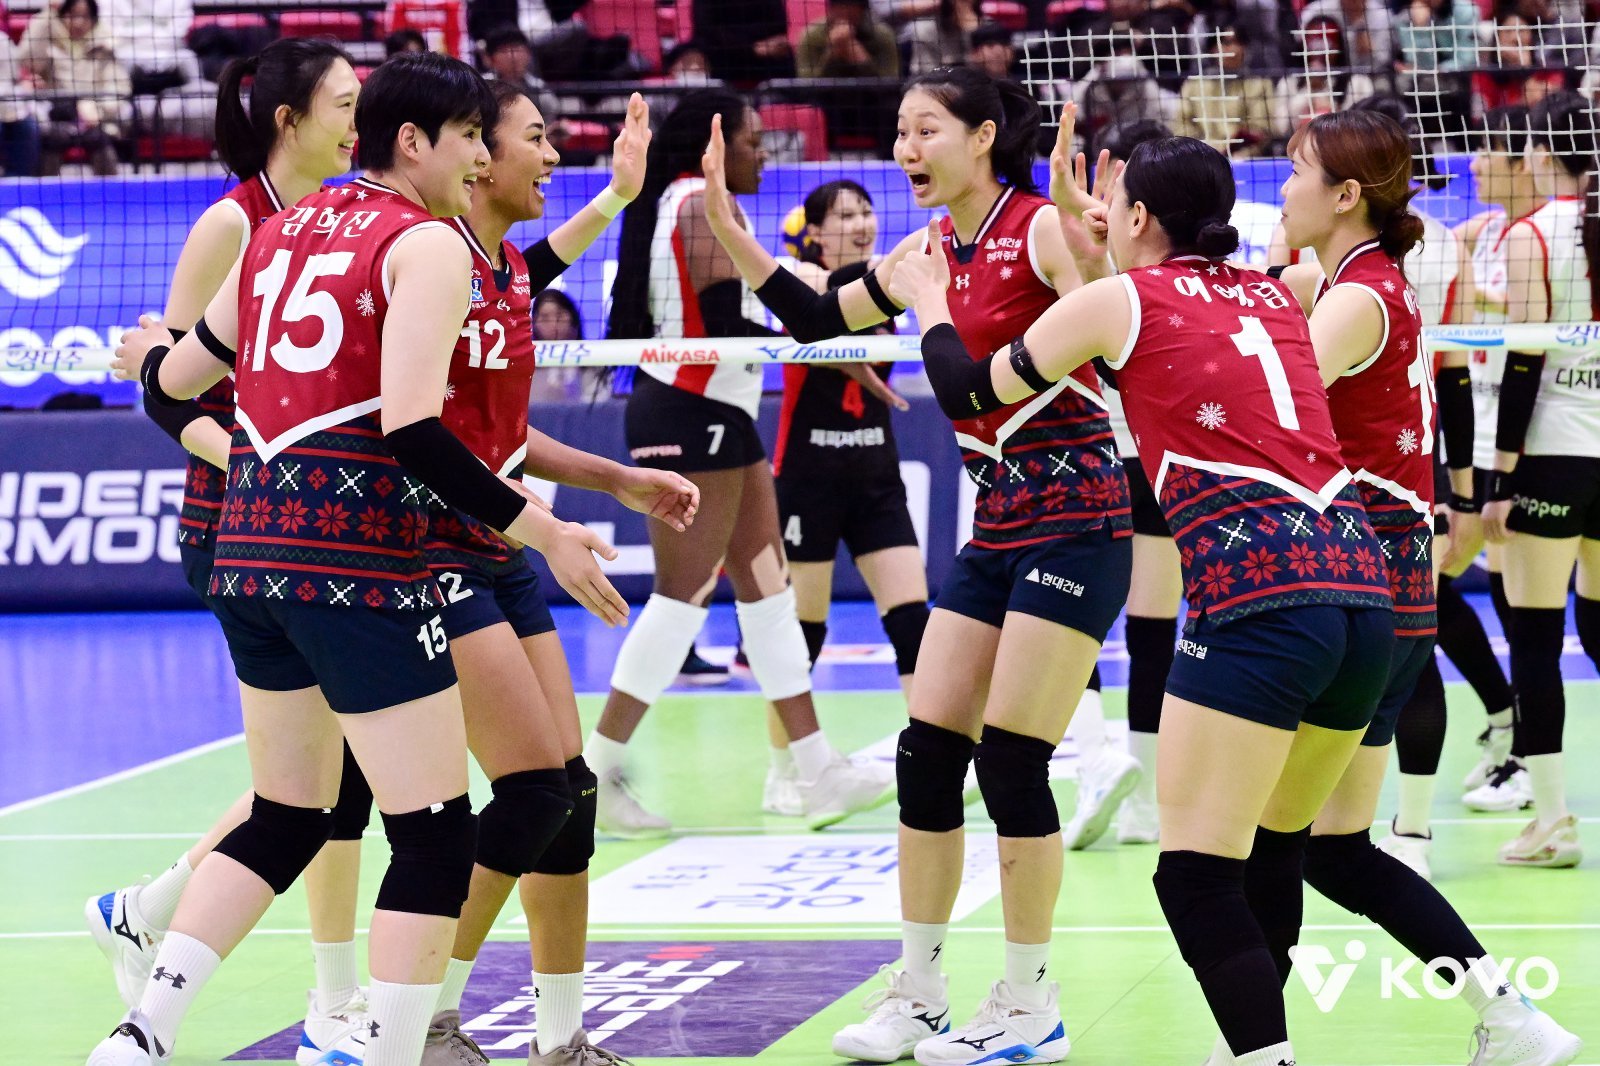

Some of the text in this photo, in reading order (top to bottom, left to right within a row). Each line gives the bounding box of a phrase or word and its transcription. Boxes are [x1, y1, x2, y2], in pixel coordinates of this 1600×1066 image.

[281, 205, 382, 241] 김희진
[996, 237, 1023, 248] 대건설
[252, 248, 356, 374] 15
[460, 318, 510, 370] 12
[1425, 328, 1503, 337] POCARI SWEAT
[1229, 315, 1301, 431] 1
[842, 378, 865, 420] 4
[706, 424, 726, 455] 7
[784, 515, 803, 546] 4
[1041, 572, 1085, 597] 현대건설
[416, 614, 448, 661] 15
